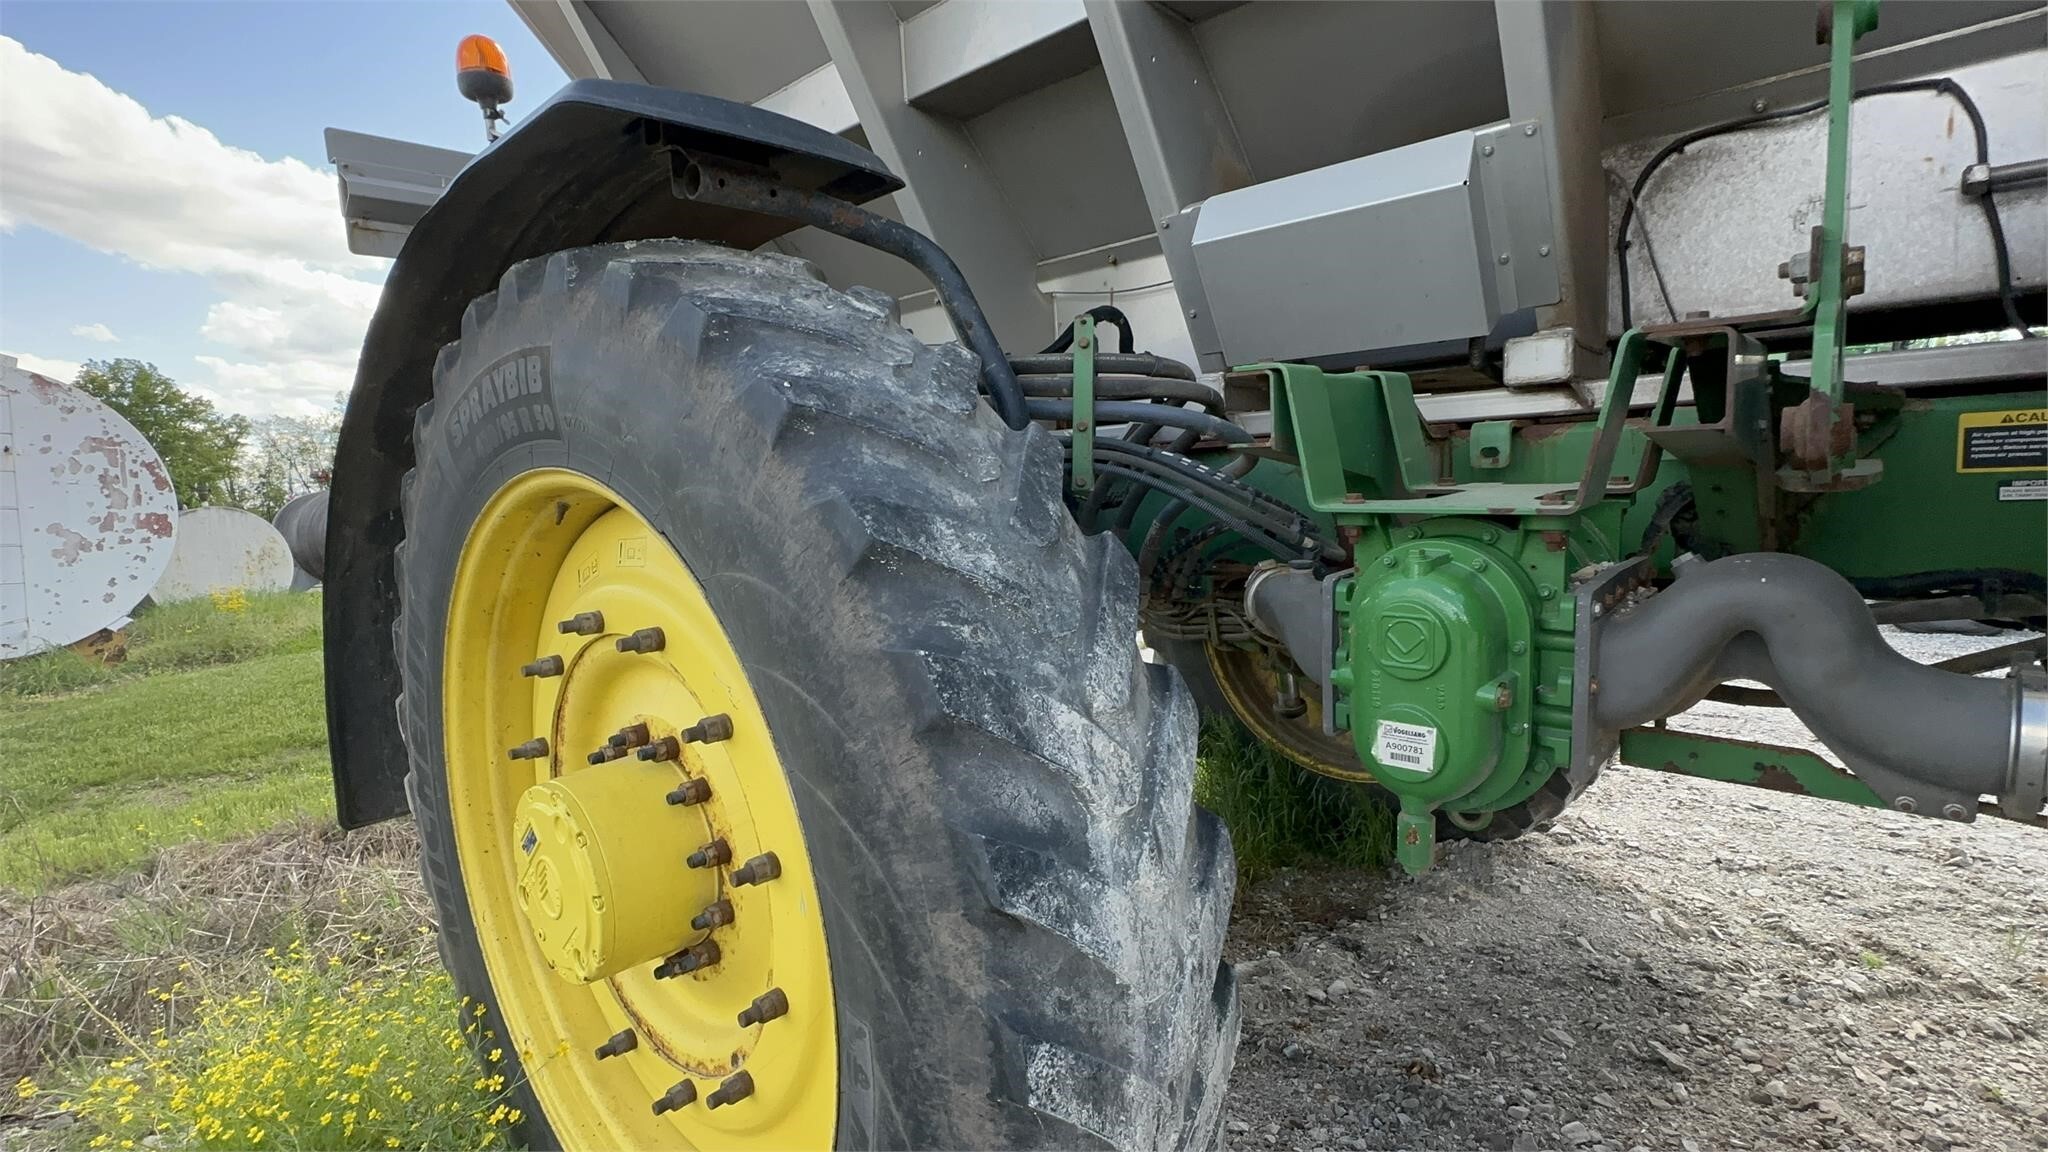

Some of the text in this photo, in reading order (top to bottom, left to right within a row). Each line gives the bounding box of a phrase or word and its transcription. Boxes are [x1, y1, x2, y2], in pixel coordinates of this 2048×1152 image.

[451, 355, 543, 448] SPRAYBIB
[533, 404, 556, 432] 50
[1393, 726, 1426, 738] VOGELSANG
[1385, 741, 1424, 755] A900781
